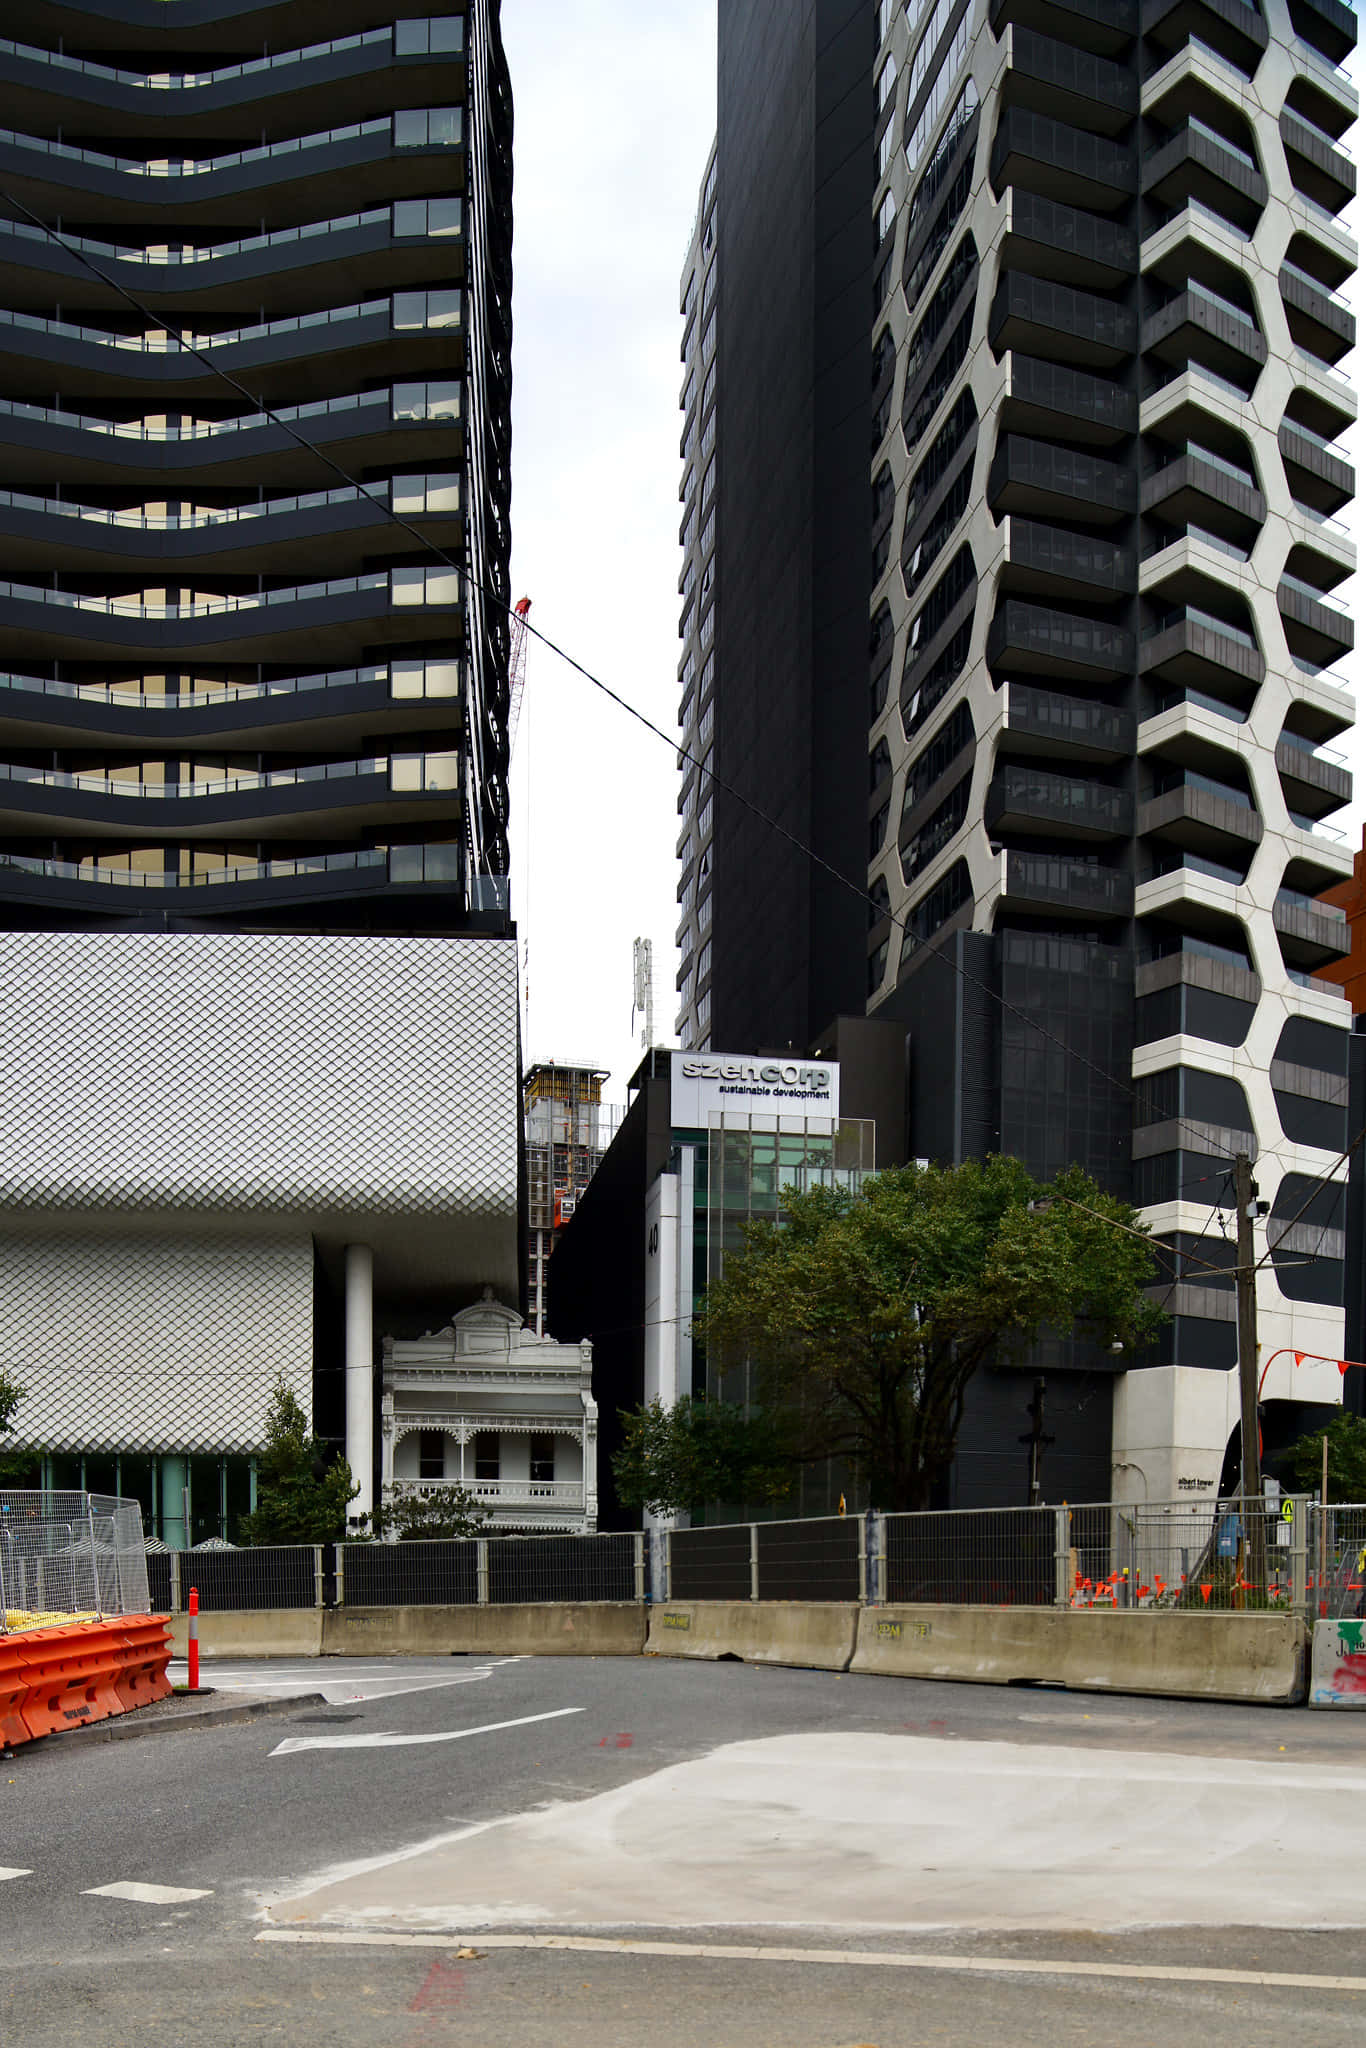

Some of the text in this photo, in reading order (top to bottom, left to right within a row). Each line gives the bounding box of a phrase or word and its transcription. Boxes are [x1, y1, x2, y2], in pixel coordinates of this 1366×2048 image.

[718, 1084, 830, 1099] sustainable development
[647, 1223, 659, 1256] 40
